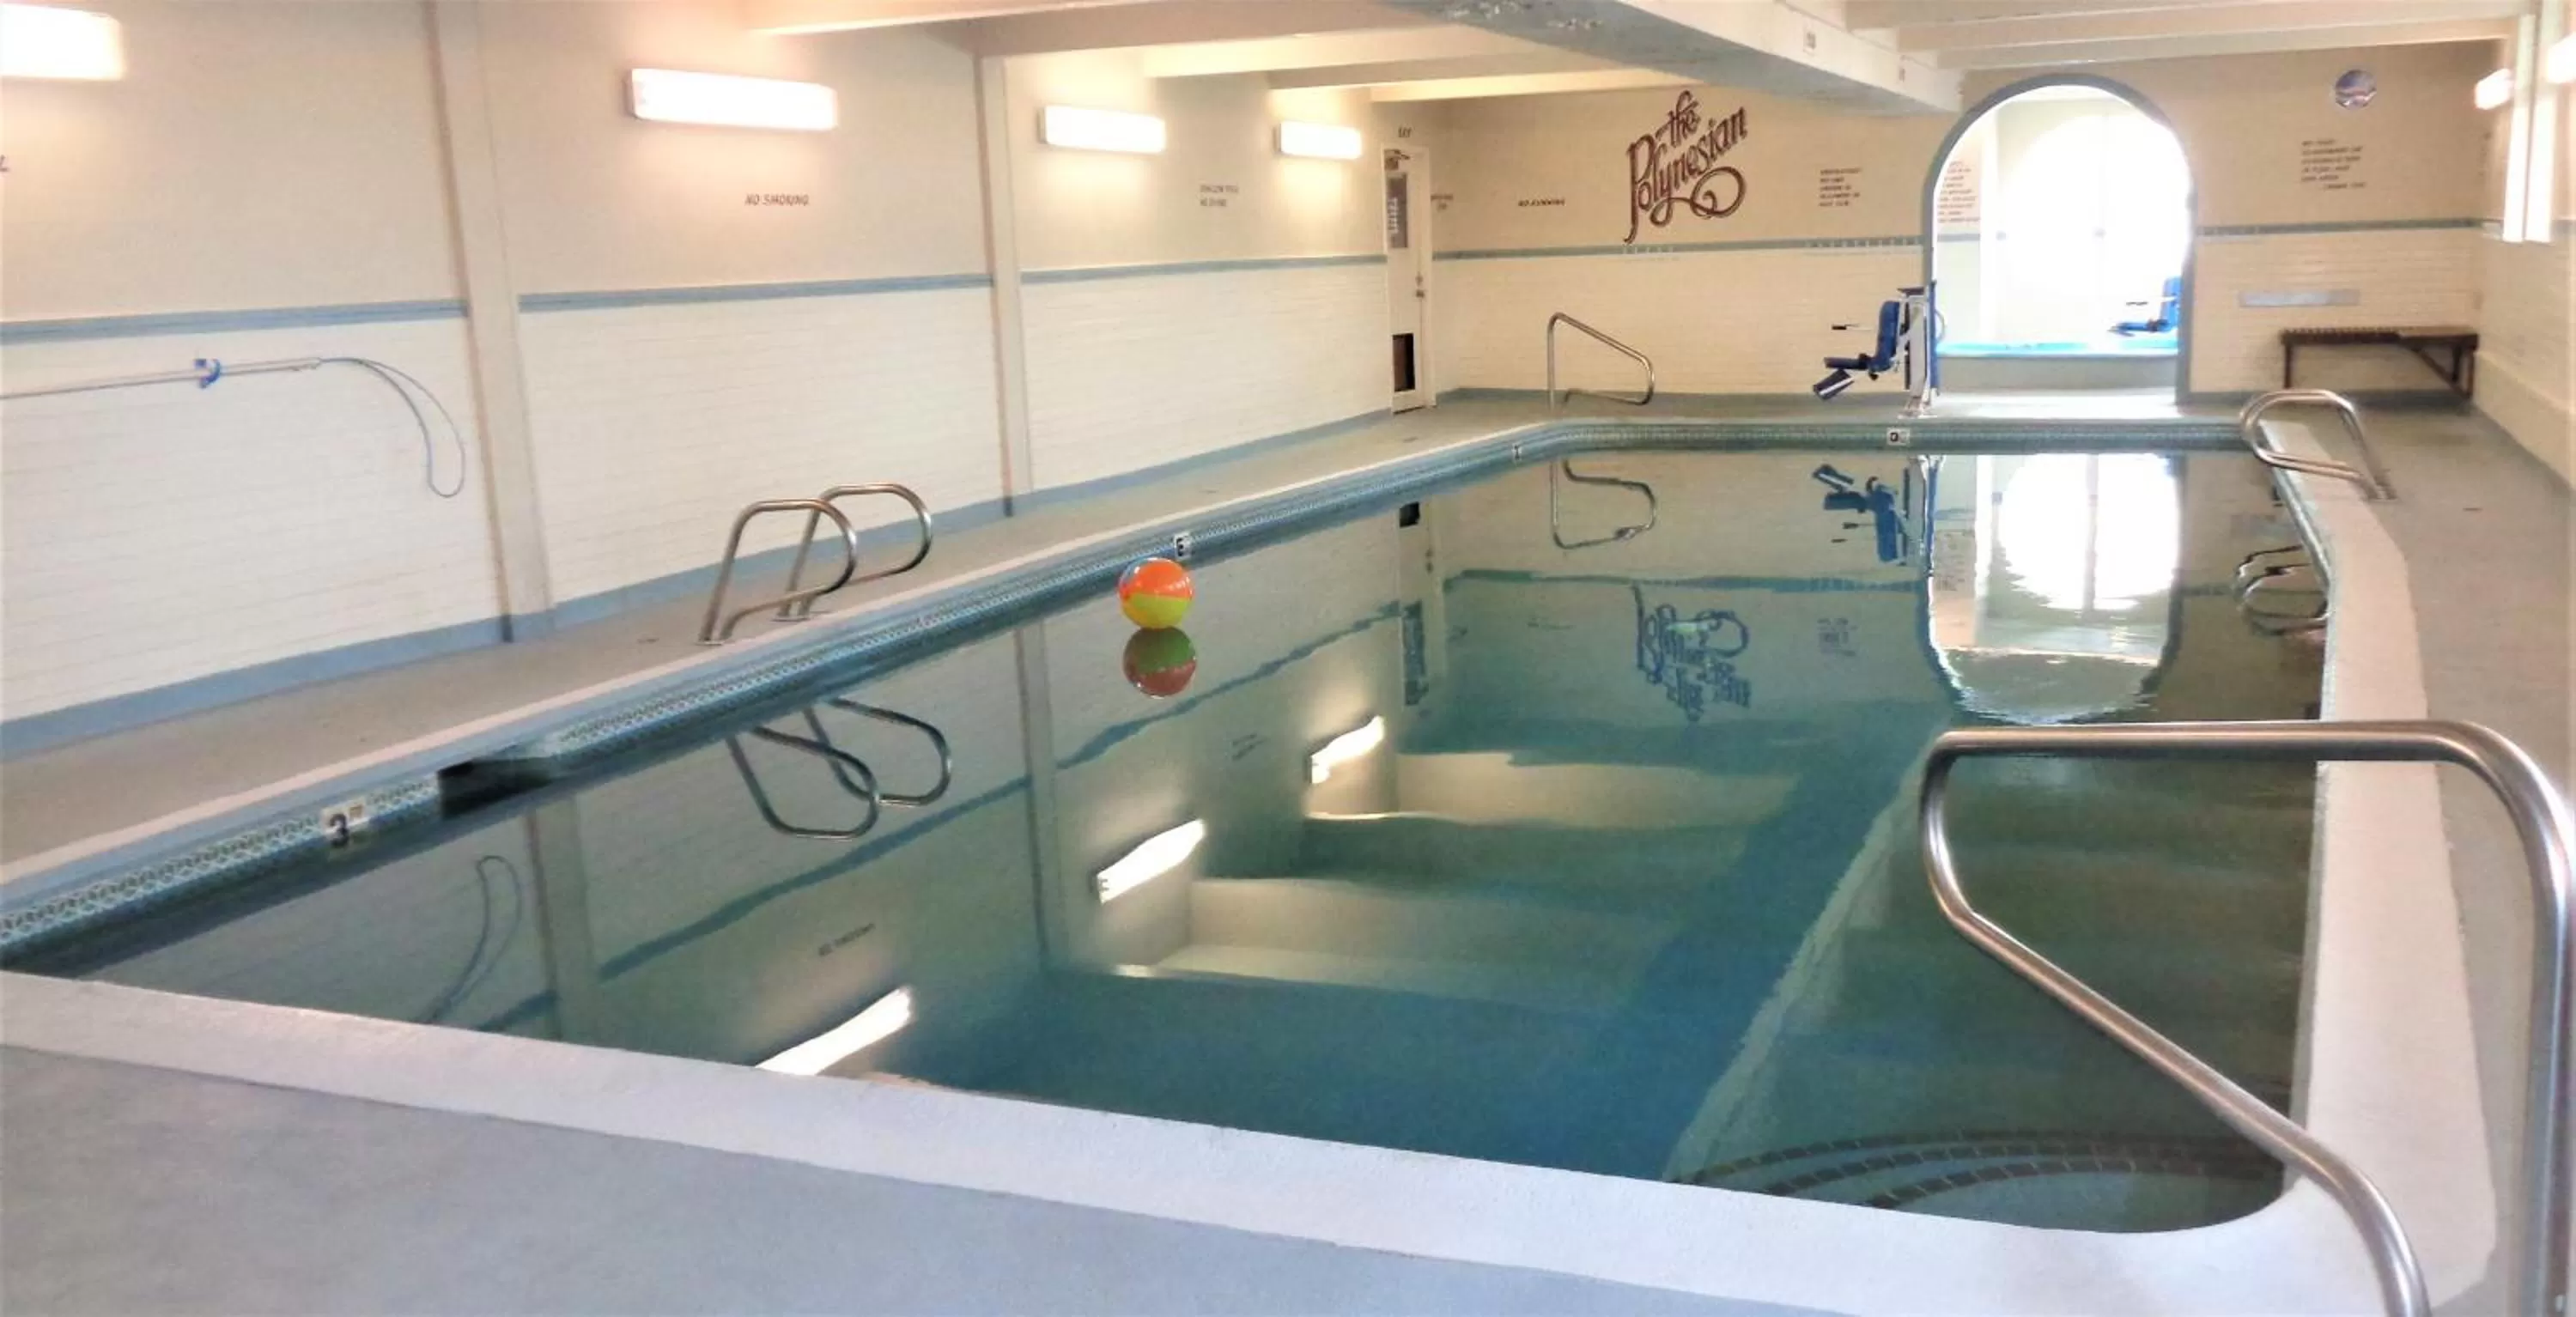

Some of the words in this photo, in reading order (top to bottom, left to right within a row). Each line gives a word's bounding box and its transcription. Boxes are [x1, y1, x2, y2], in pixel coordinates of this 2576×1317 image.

[1656, 90, 1700, 148] the
[744, 193, 759, 206] NO
[1623, 106, 1748, 245] Polynesian
